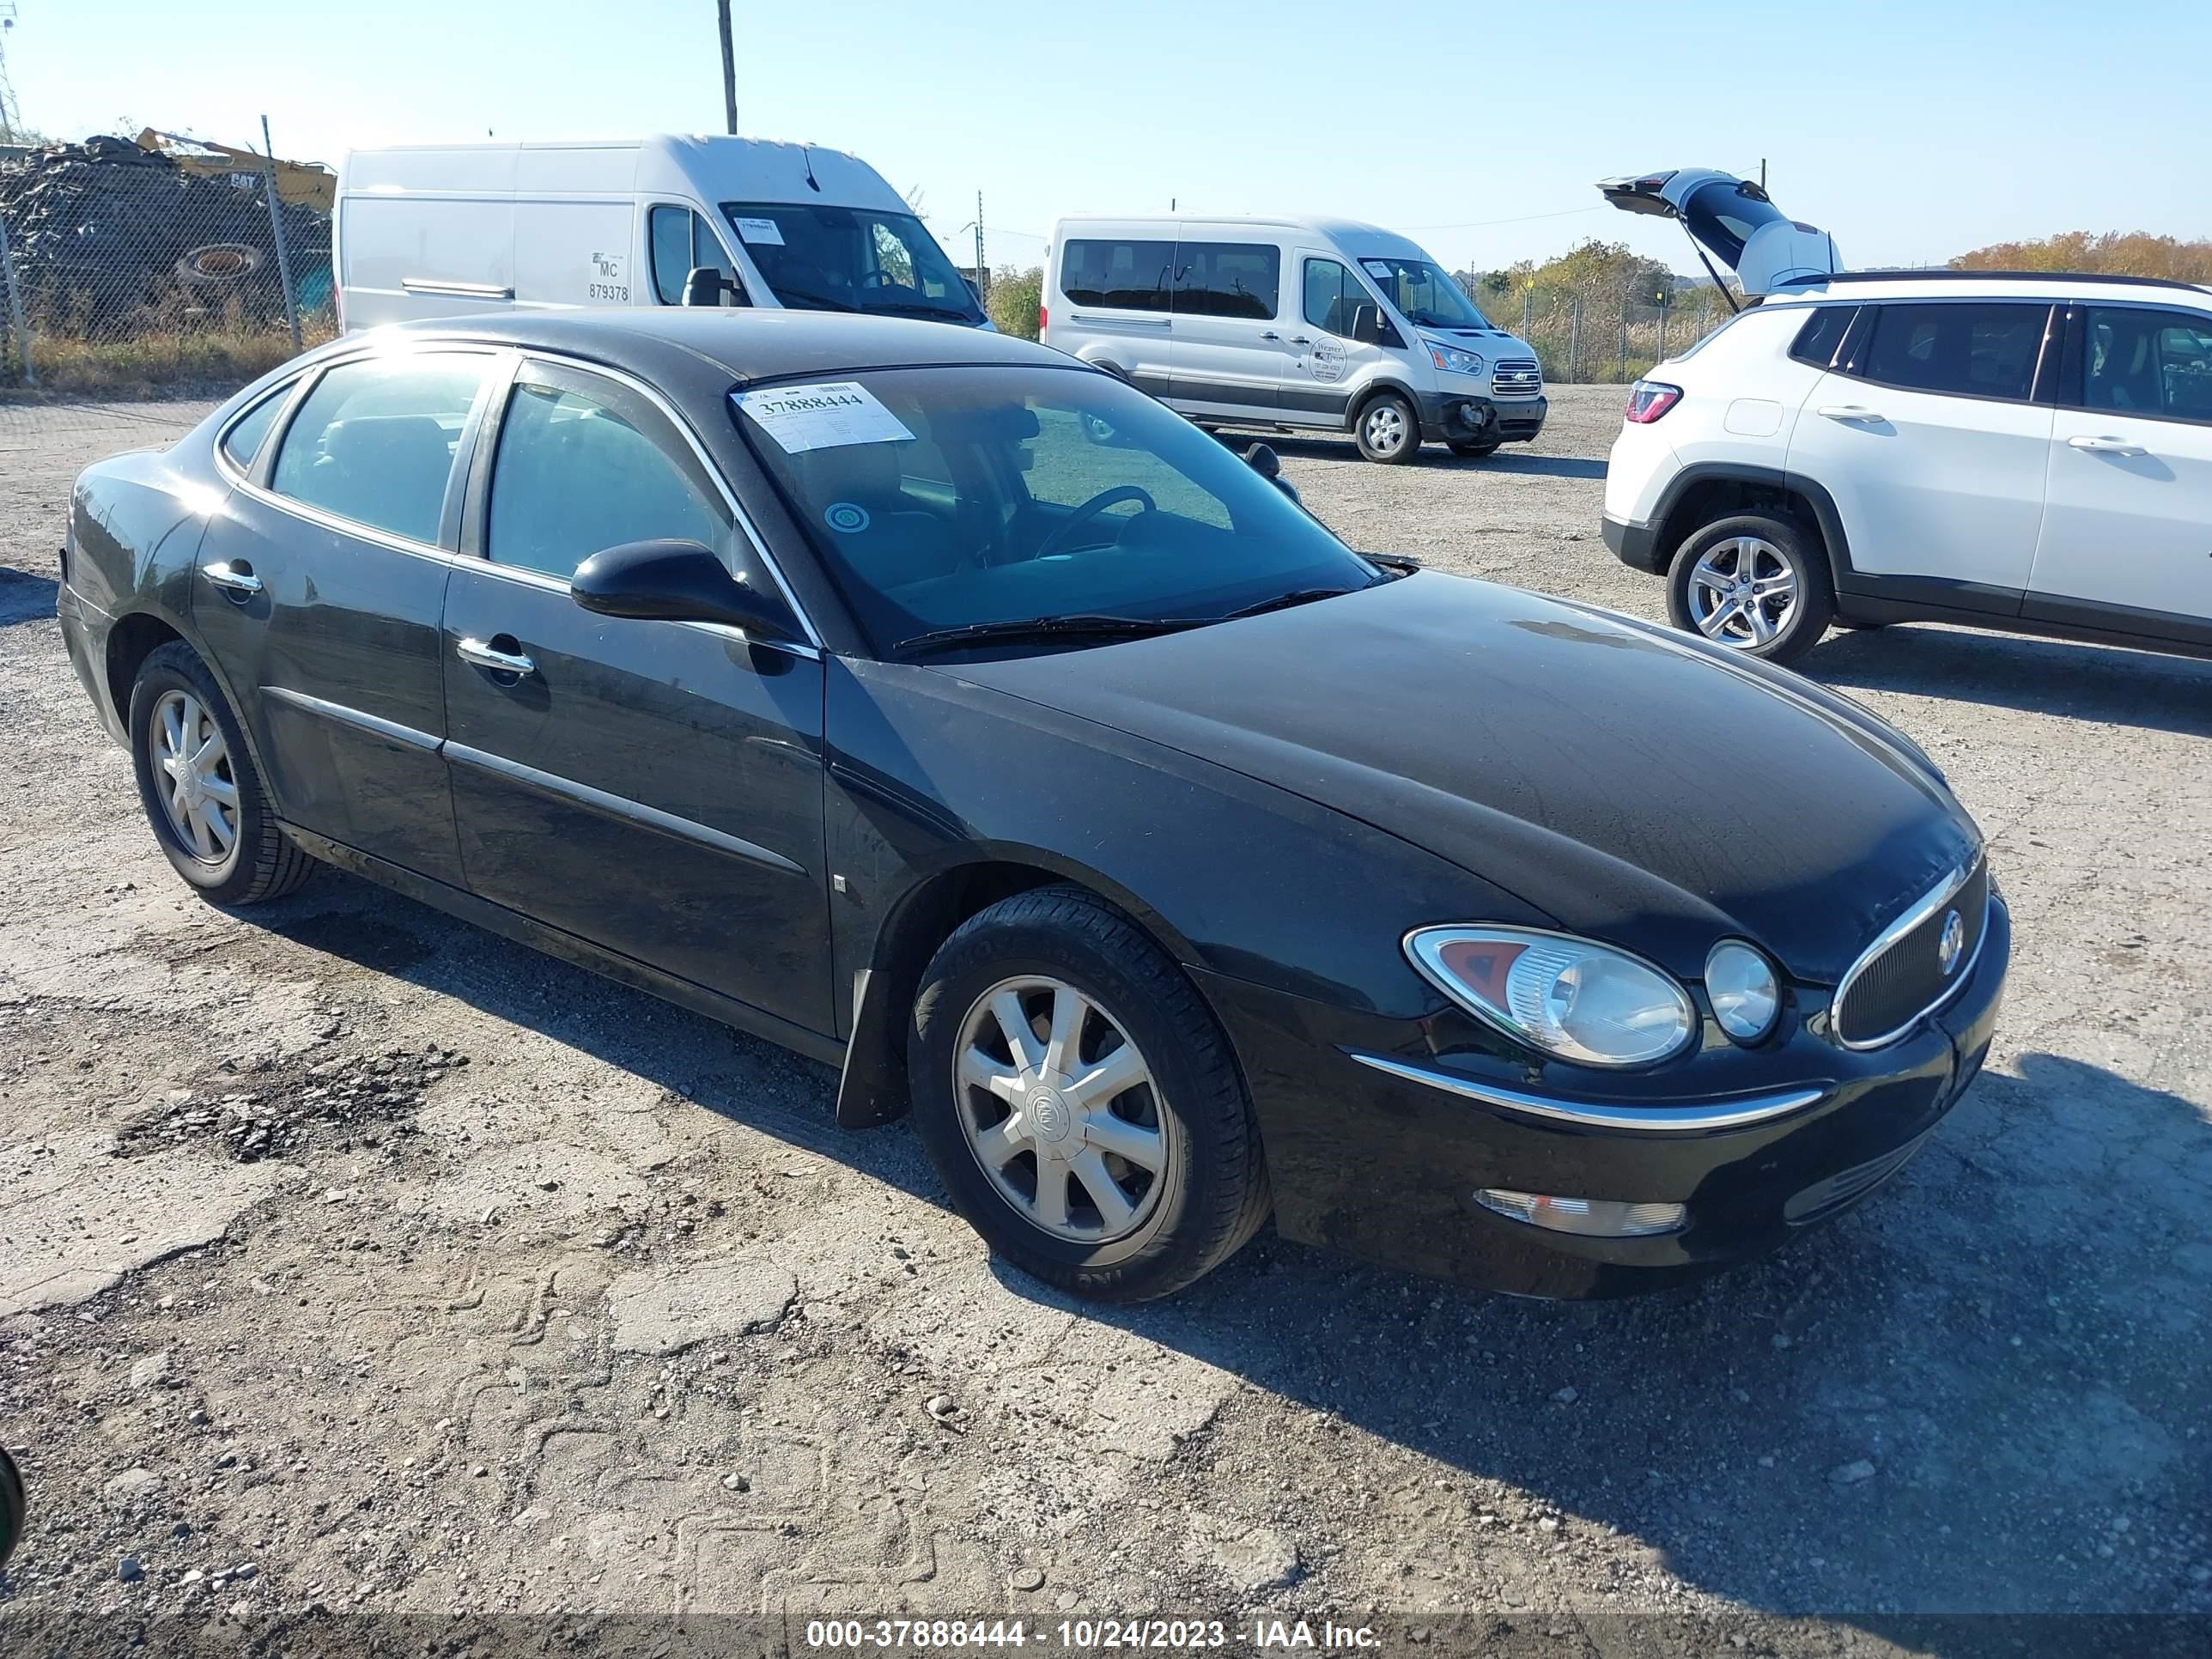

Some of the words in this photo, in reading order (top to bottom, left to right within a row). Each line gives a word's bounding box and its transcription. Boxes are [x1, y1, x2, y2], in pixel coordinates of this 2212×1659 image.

[231, 173, 255, 189] CAT
[600, 263, 617, 277] MC
[589, 283, 629, 301] 879378
[1318, 343, 1342, 352] Weaver
[758, 393, 864, 416] 37888444
